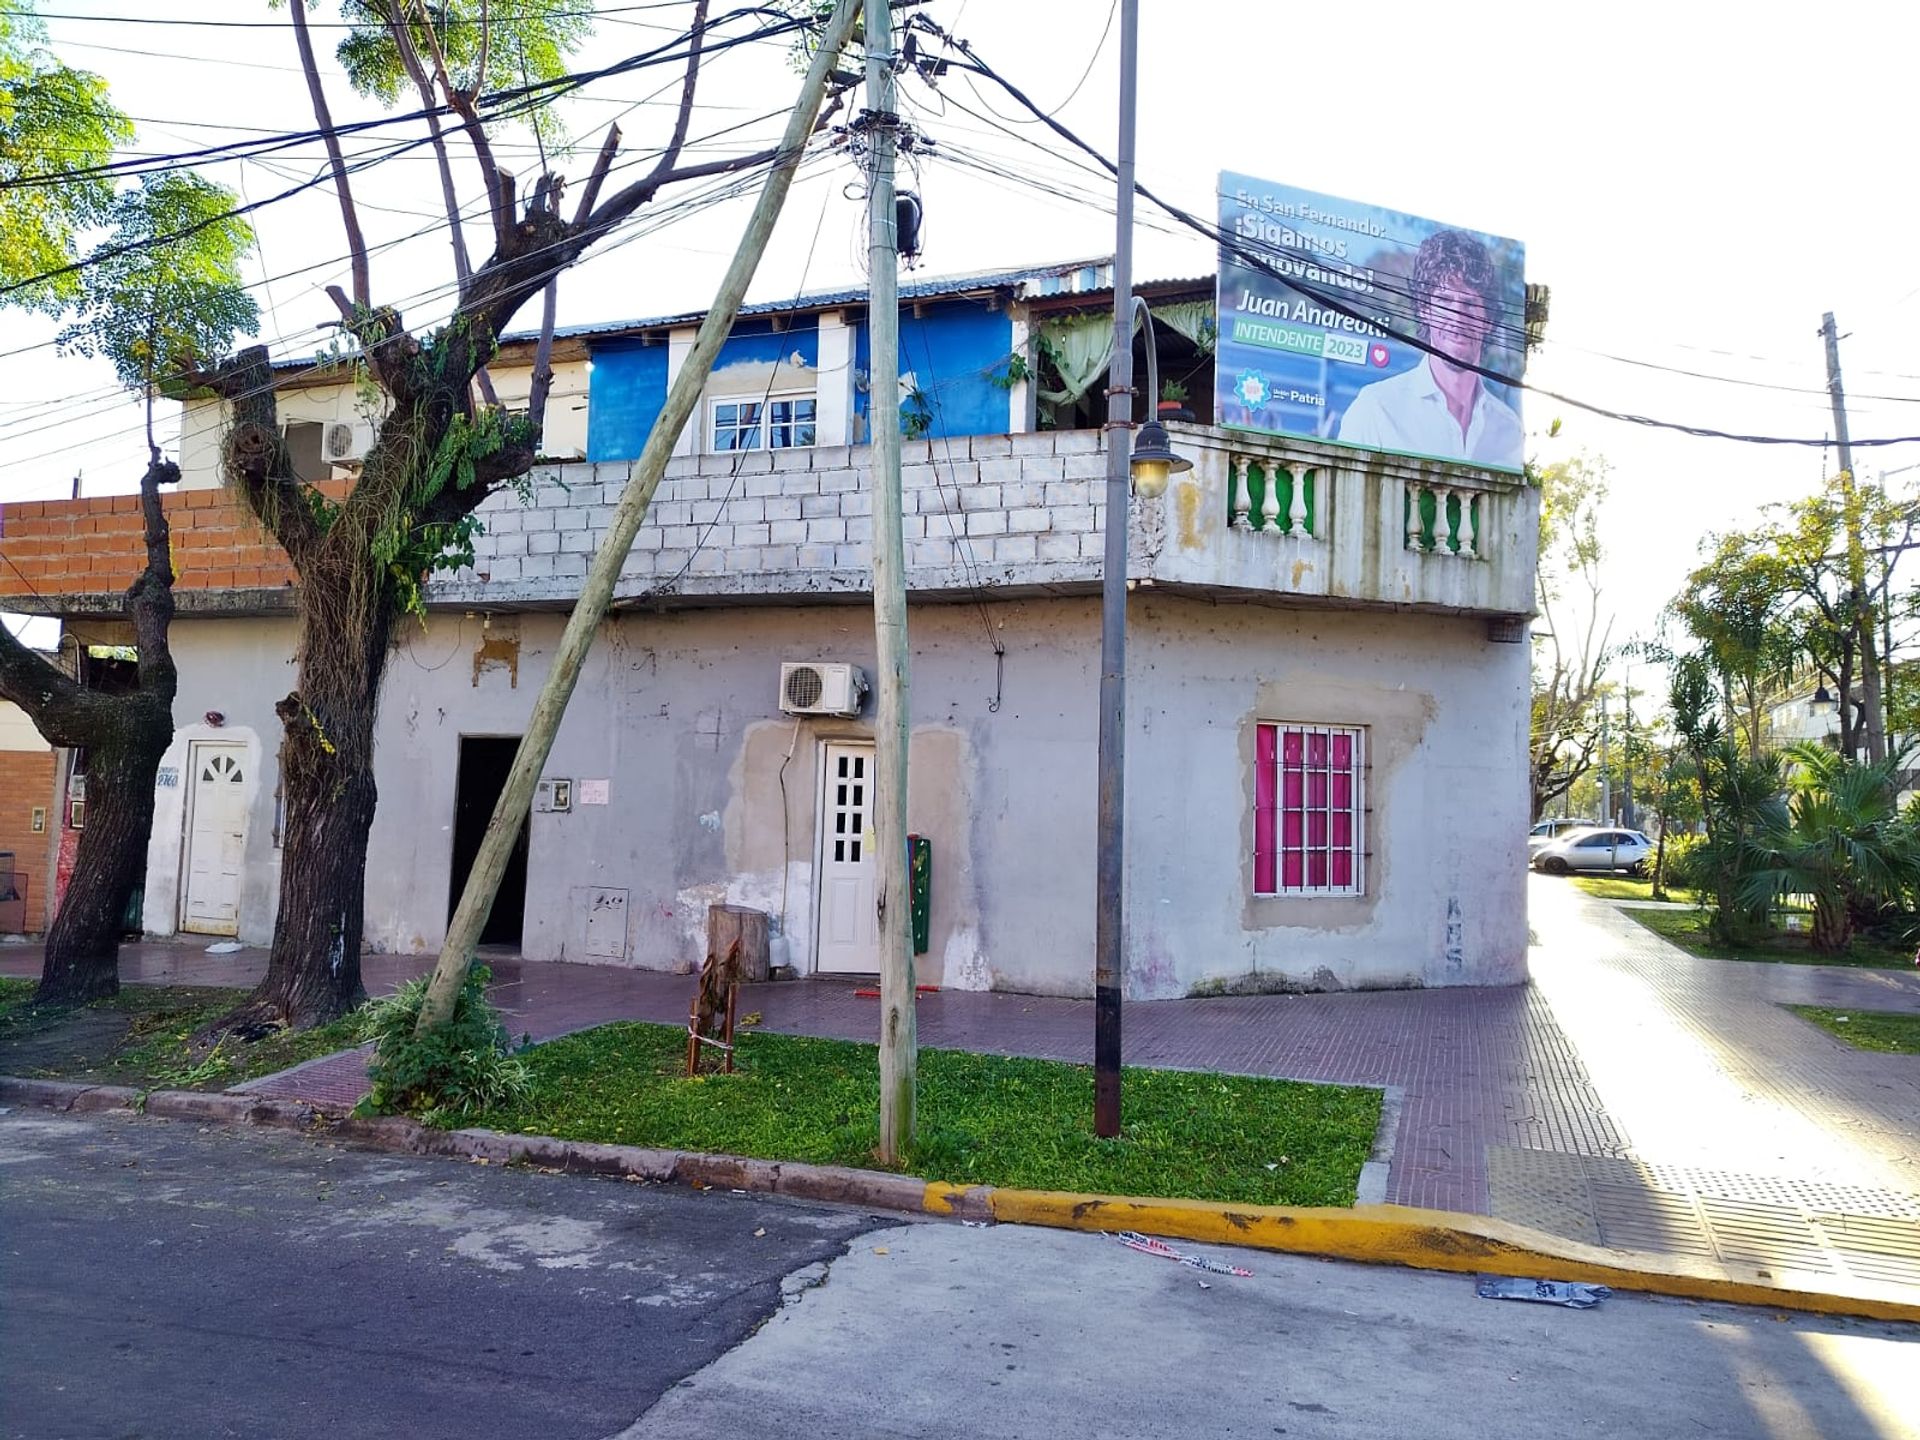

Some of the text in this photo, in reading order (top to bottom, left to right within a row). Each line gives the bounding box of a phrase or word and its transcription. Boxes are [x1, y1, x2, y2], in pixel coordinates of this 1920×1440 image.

[1235, 213, 1348, 258] ¡Sigamos
[1236, 189, 1386, 238] En San Fernando:
[1236, 290, 1391, 339] Juan Andreotti
[1235, 321, 1364, 359] INTENDENTE 2023
[1290, 390, 1326, 406] Patria
